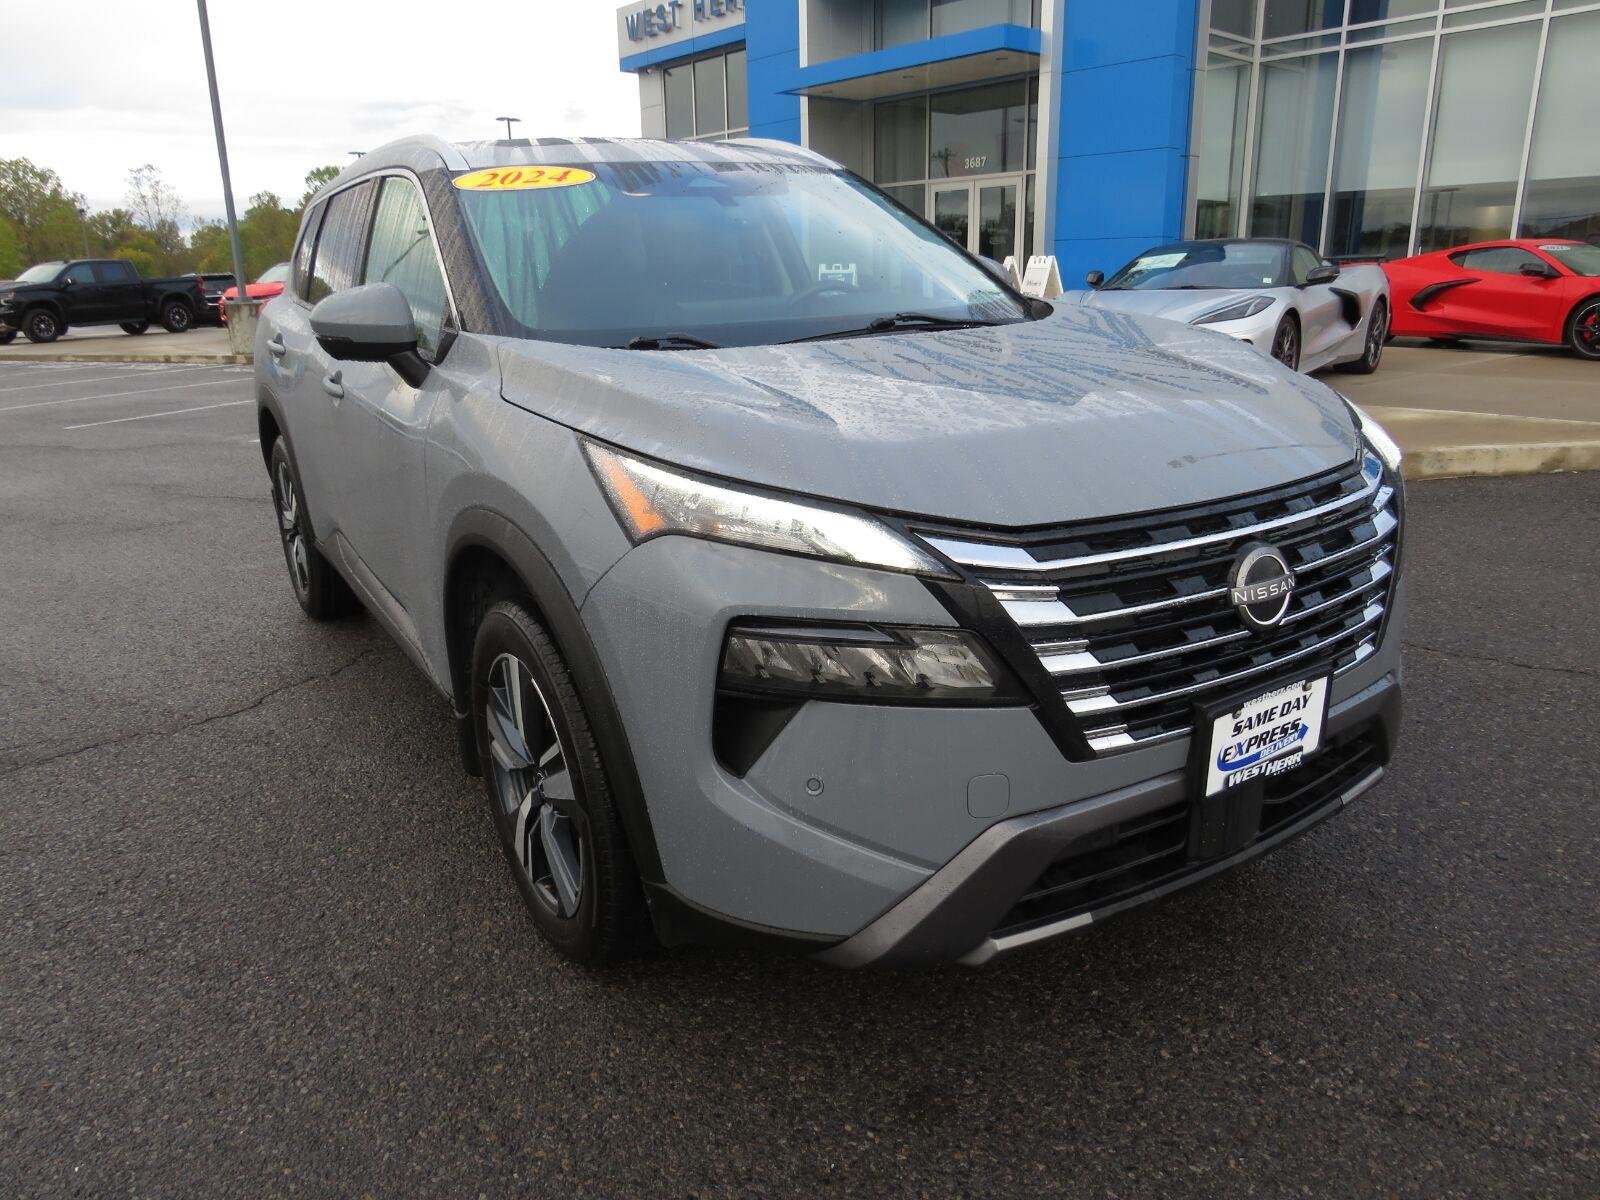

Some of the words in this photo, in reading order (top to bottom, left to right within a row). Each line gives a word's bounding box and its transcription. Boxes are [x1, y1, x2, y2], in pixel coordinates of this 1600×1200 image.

[625, 0, 684, 42] WEST
[964, 156, 987, 169] 3687
[474, 170, 572, 187] 2024
[1234, 575, 1295, 603] NISSAN
[1231, 706, 1278, 737] SAME
[1279, 693, 1313, 718] DAY
[1222, 717, 1301, 763] EXPRESS
[1259, 732, 1300, 758] DELIVERY
